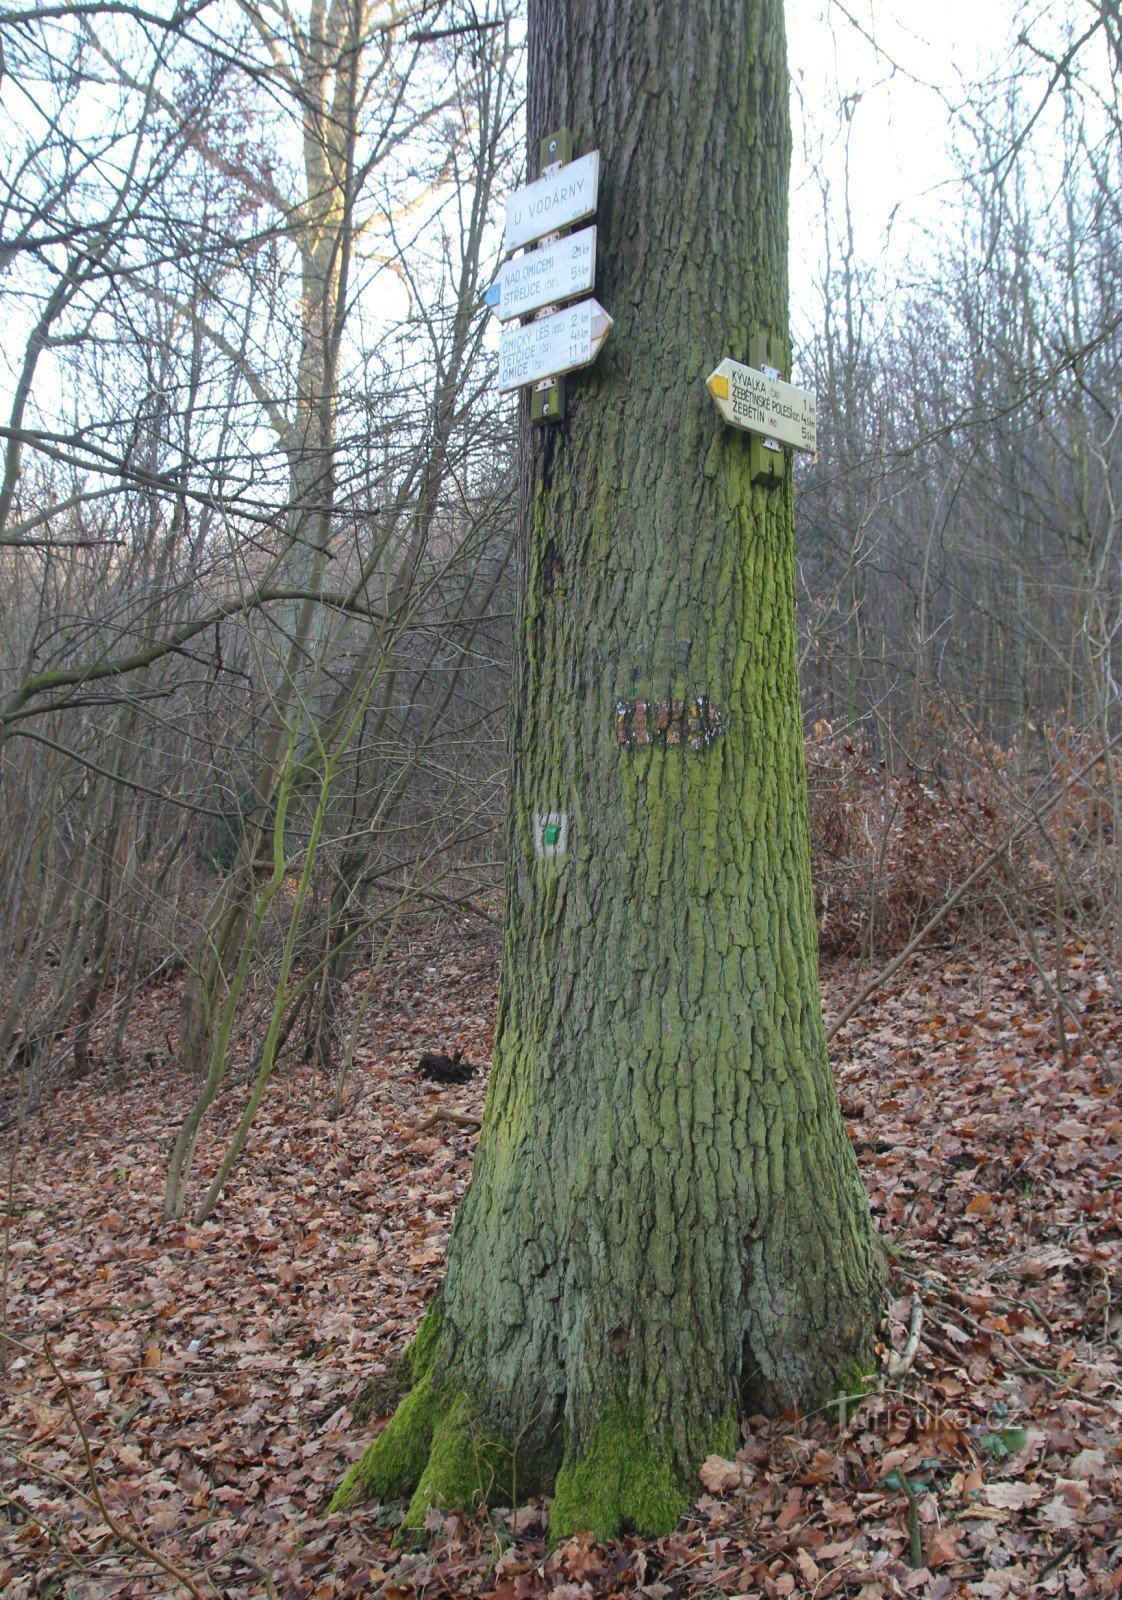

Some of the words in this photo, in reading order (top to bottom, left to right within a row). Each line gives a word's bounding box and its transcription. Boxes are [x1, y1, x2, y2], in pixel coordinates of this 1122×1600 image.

[514, 210, 522, 225] U
[528, 178, 585, 218] VODÁRNY
[504, 270, 521, 287] NAD
[503, 281, 541, 306] STŘELICE
[502, 329, 533, 354] OMICKÝ
[535, 324, 550, 341] LES
[571, 314, 578, 327] 2
[502, 345, 536, 368] TETČICE
[502, 362, 529, 382] OMICE
[569, 344, 577, 358] 11
[731, 369, 767, 395] KÝVALKA
[803, 399, 807, 412] 1
[731, 397, 765, 423] ŽEBĚTÍN
[771, 400, 793, 418] POLESÍ
